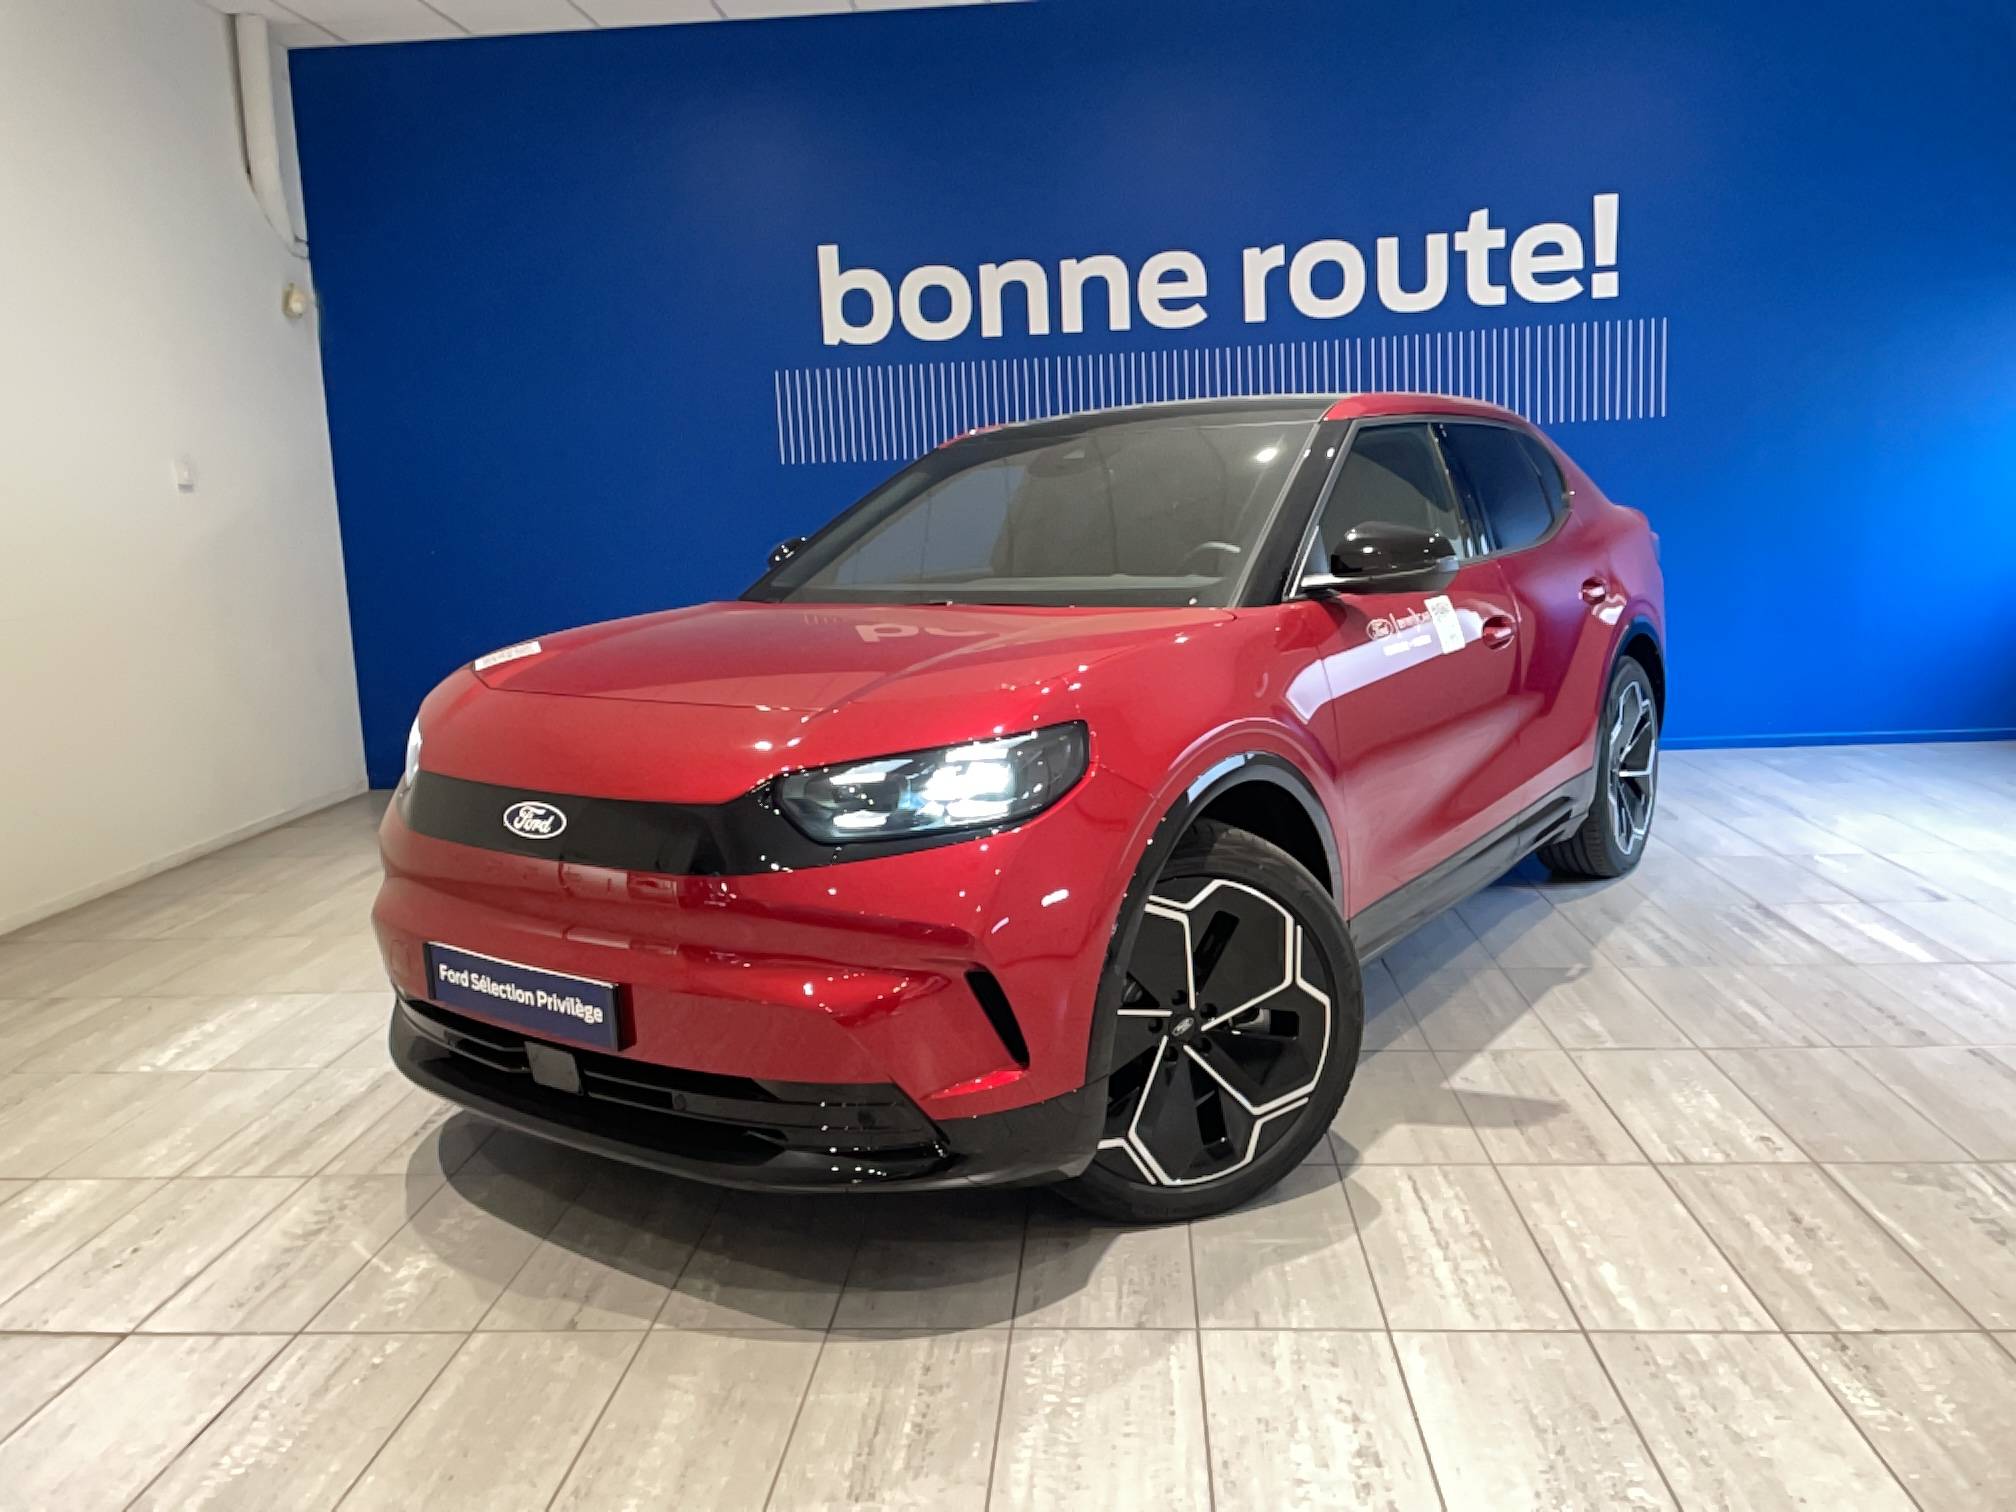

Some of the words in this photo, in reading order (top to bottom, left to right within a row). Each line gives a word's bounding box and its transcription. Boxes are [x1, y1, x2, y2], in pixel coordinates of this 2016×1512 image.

[817, 244, 1208, 346] bonne
[1242, 193, 1619, 323] route!
[513, 805, 555, 833] Ford
[438, 964, 469, 988] Ford
[471, 973, 535, 1006] Sélection
[537, 989, 604, 1024] Privilège
